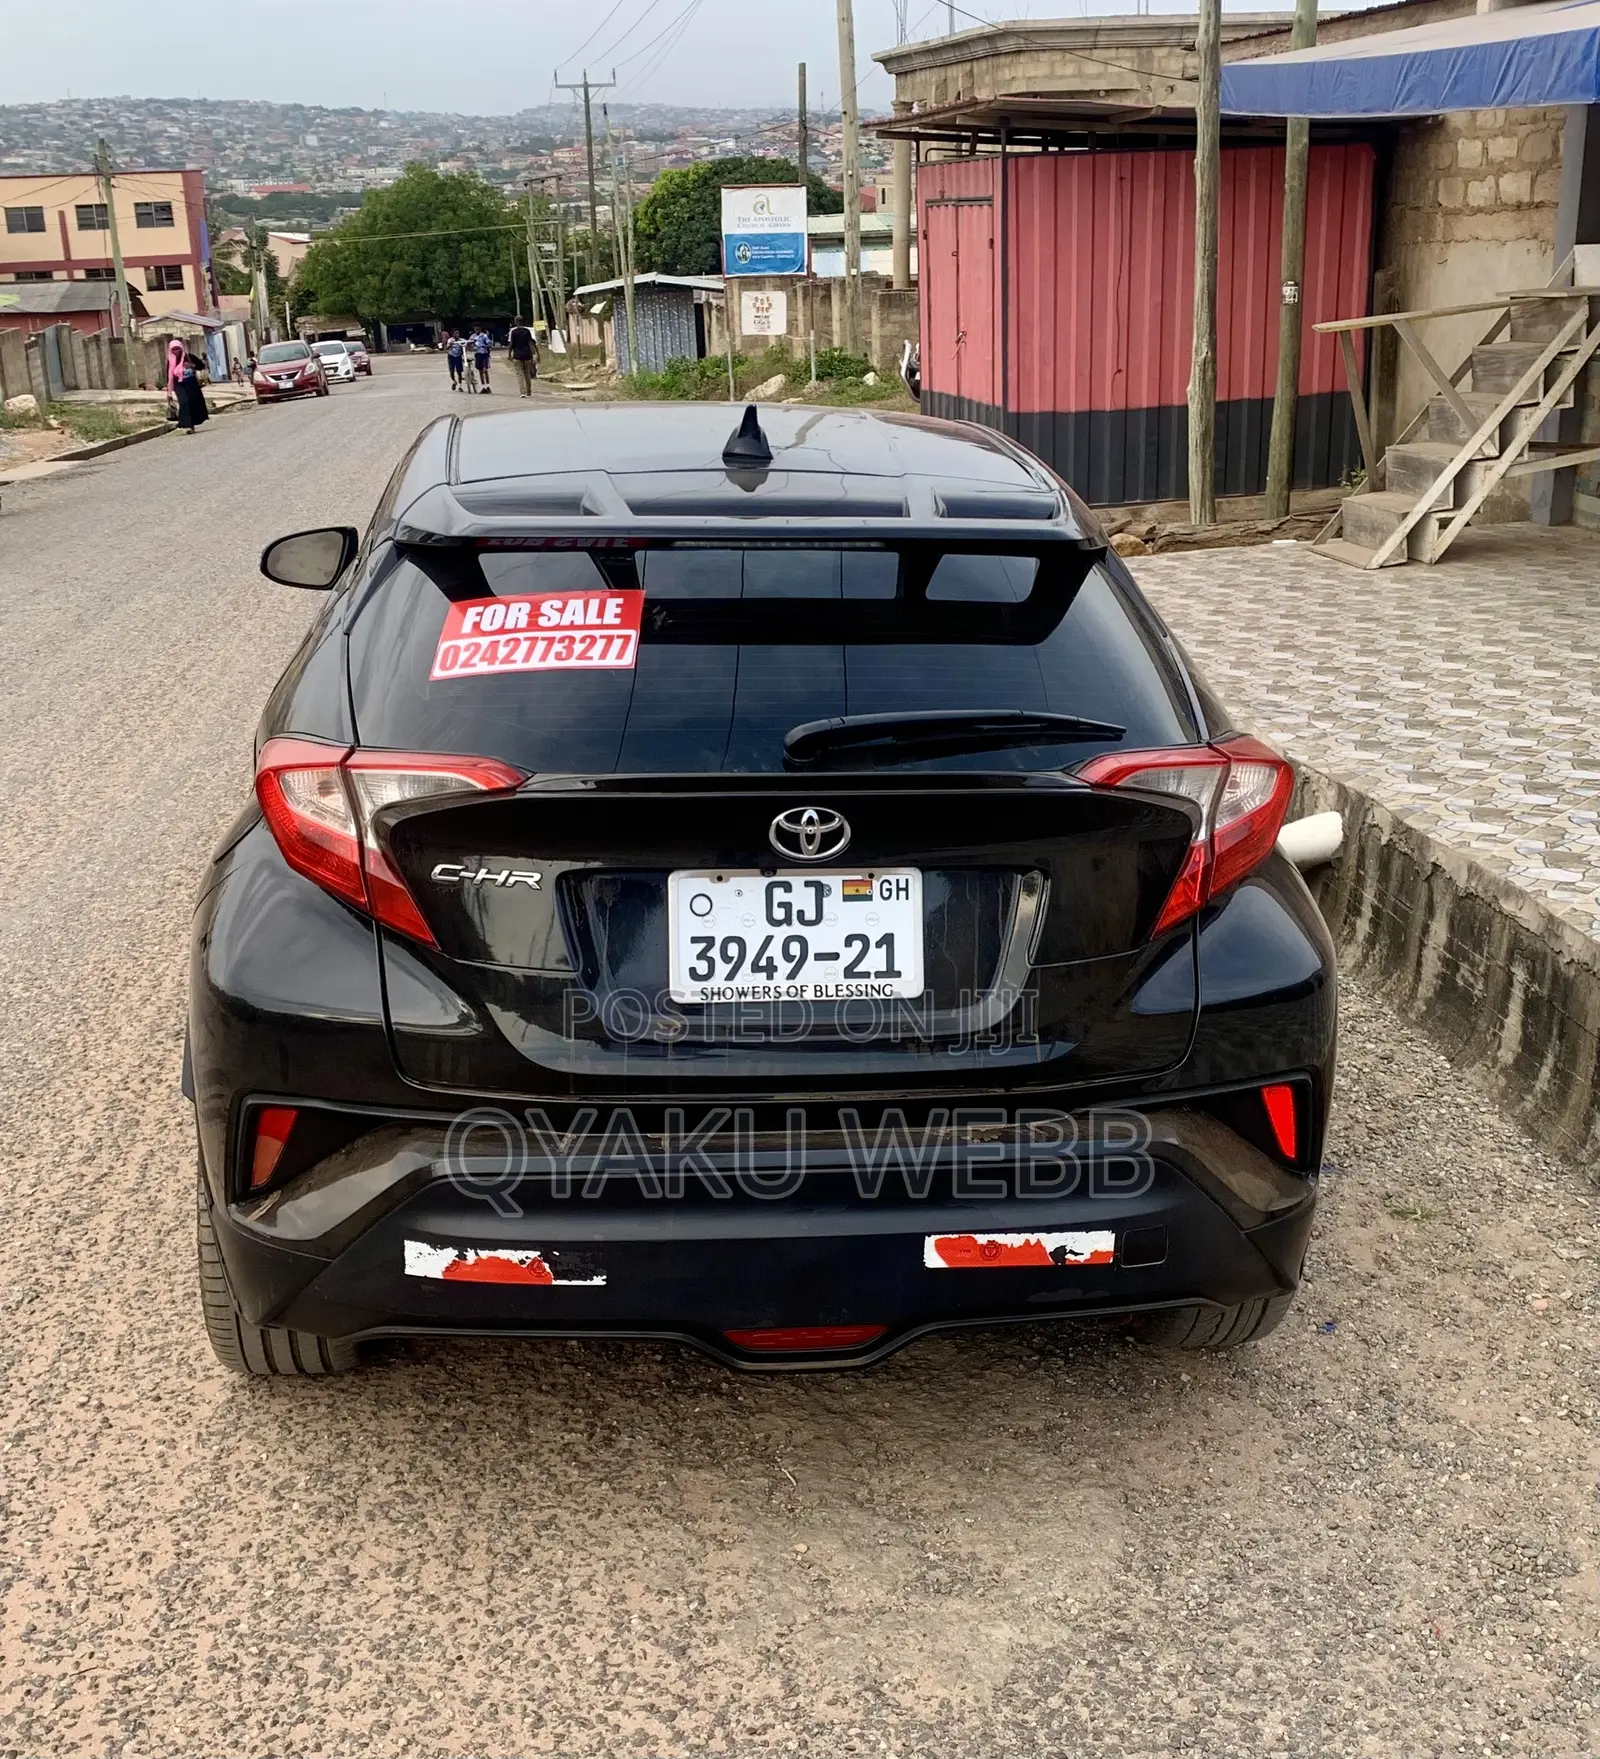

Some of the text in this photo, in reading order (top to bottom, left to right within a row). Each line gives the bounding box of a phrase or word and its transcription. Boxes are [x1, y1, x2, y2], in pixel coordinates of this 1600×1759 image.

[461, 598, 624, 634] FOR SALE
[439, 634, 632, 671] 0242773277
[431, 863, 542, 890] C-HR
[879, 878, 909, 901] GH
[765, 880, 824, 927] GJ
[688, 932, 902, 982] 3949-21
[700, 983, 894, 1001] SHOWERS OF BLESSING
